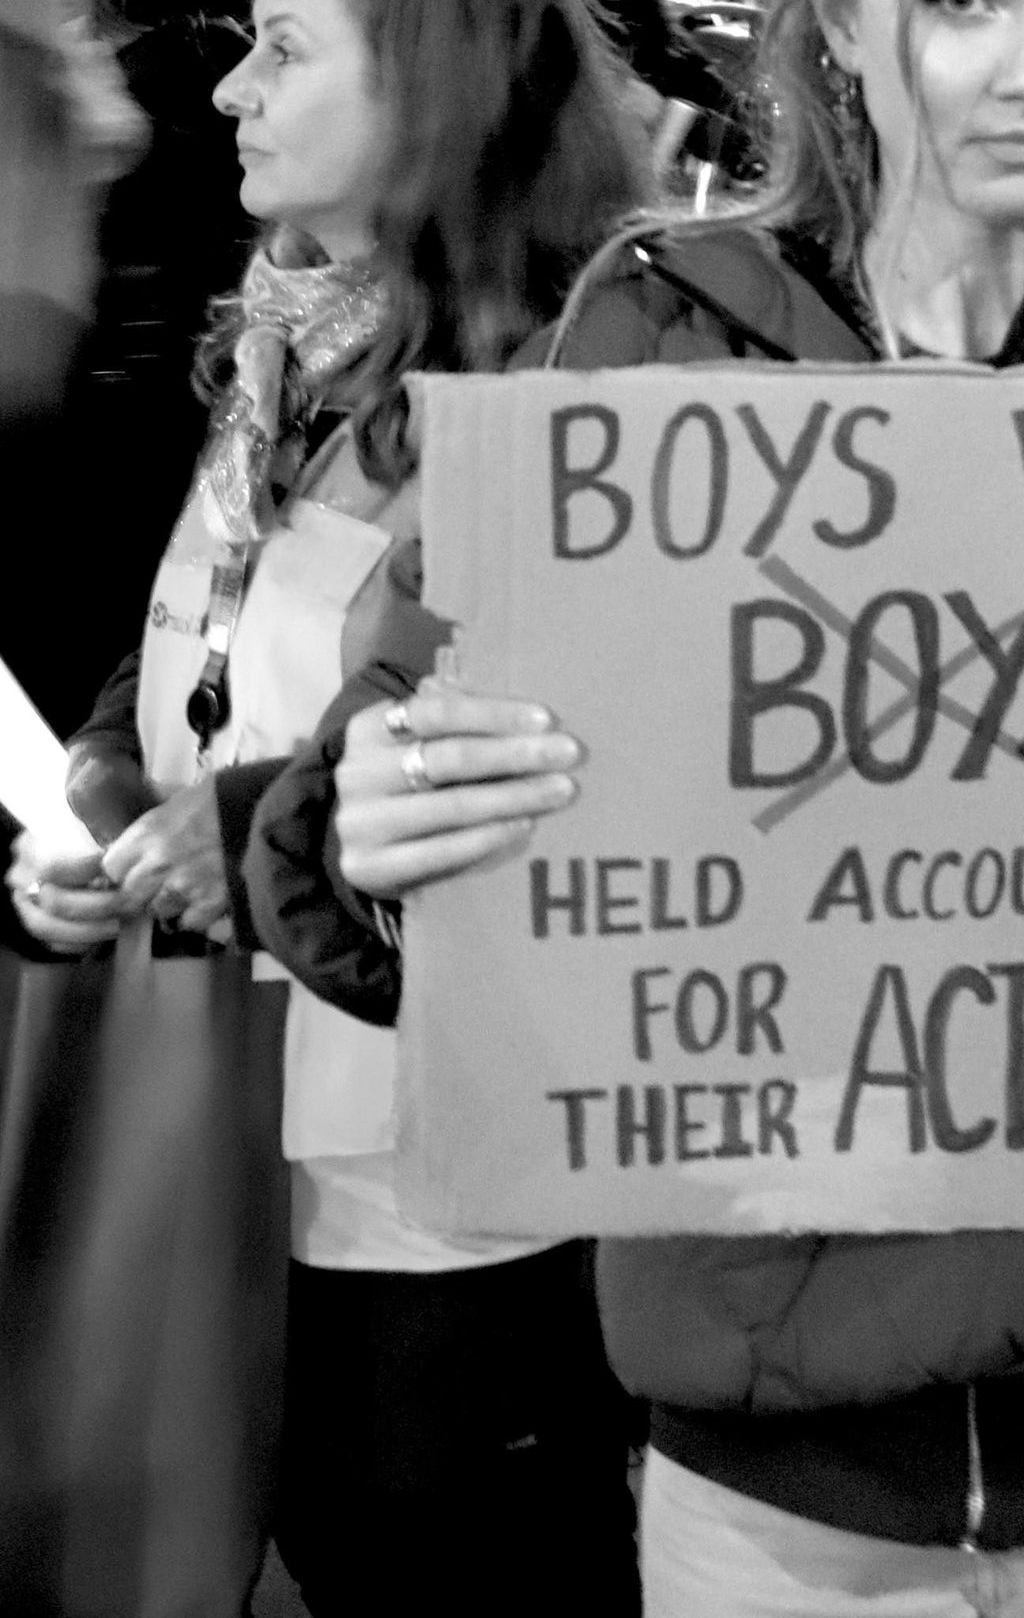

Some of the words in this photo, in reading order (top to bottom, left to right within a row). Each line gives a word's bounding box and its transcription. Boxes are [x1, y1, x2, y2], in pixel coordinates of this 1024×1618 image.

[549, 399, 898, 561] BOYS
[528, 853, 745, 939] HELD
[631, 960, 790, 1062] FOR
[545, 1078, 800, 1172] THEIR
